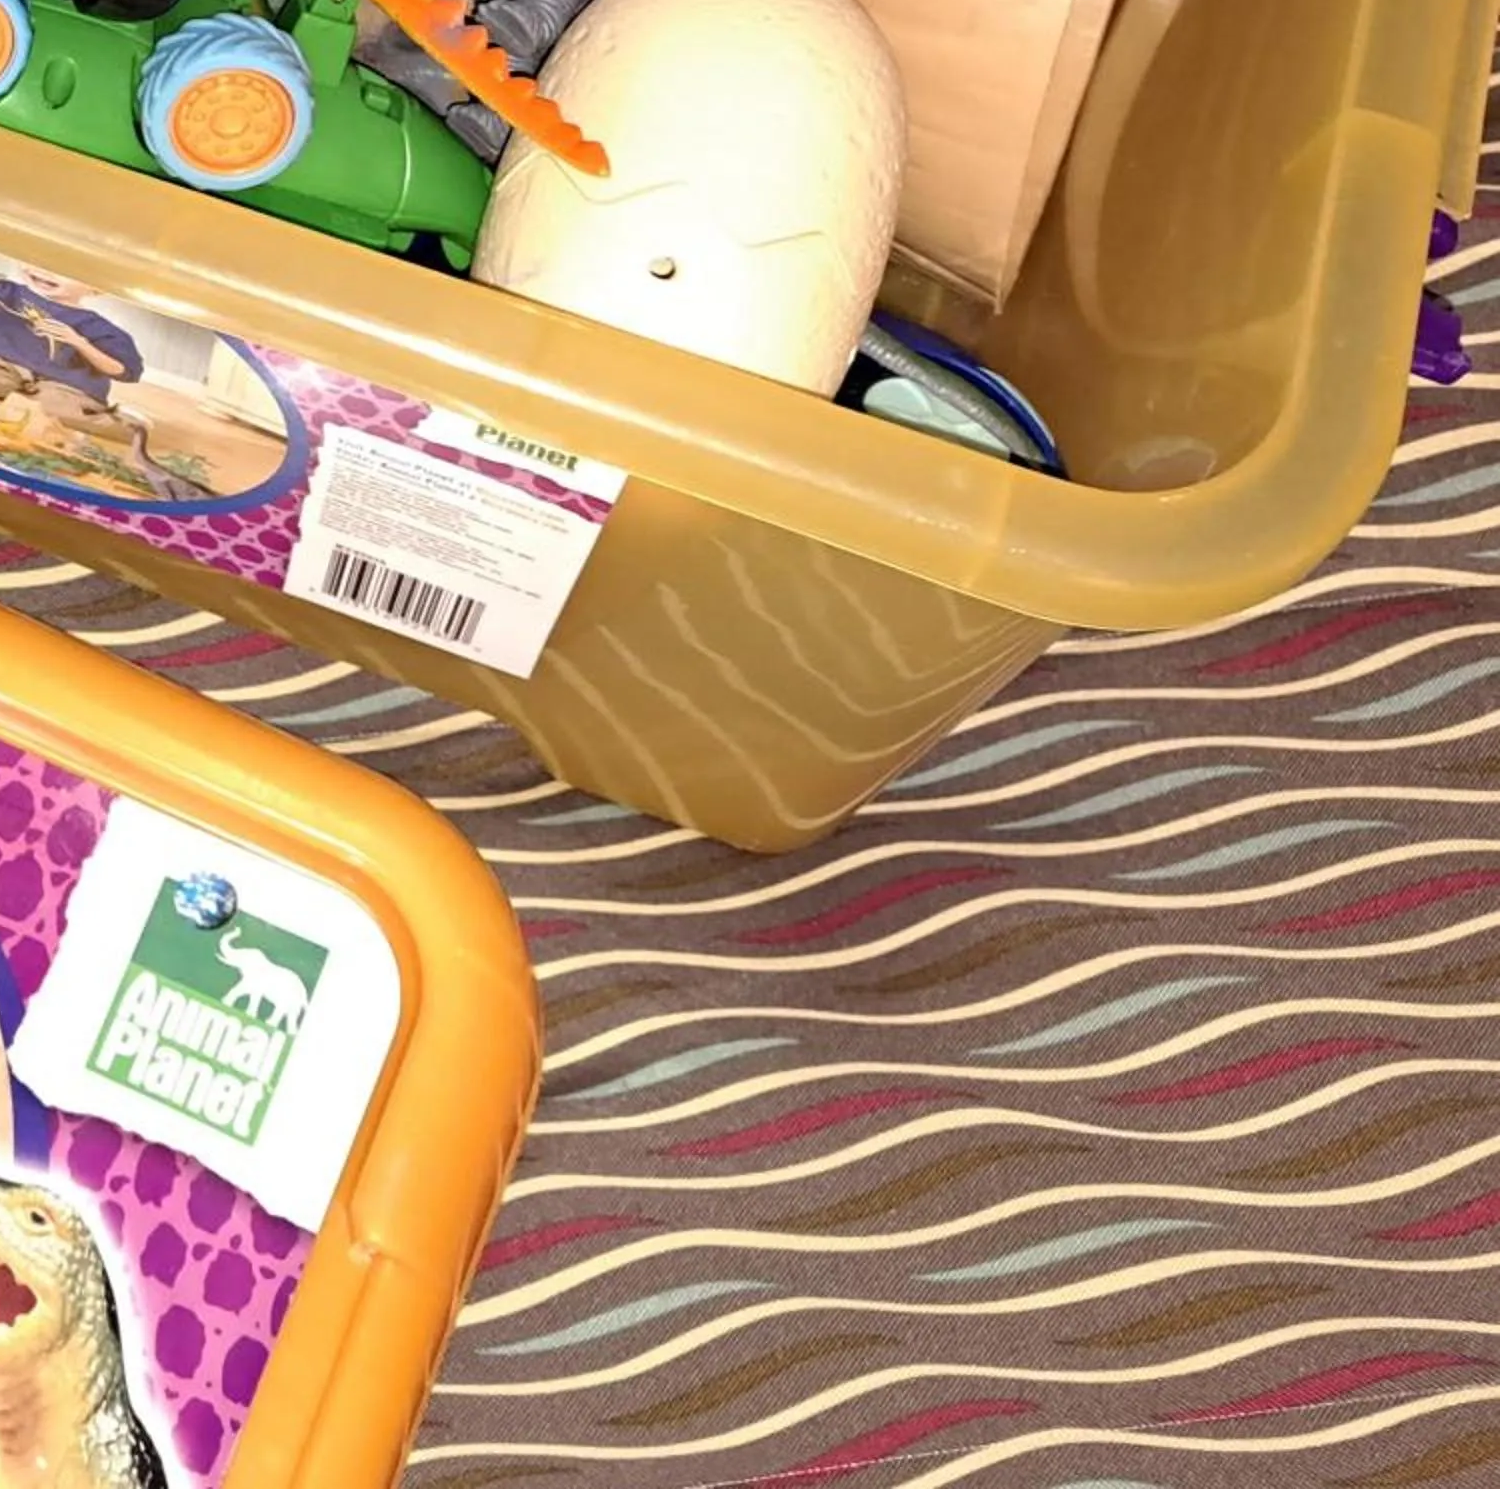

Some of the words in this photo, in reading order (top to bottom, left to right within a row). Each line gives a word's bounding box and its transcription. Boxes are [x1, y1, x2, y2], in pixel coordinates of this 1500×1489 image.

[475, 422, 578, 472] Planet
[95, 1022, 266, 1137] Planet
[115, 970, 287, 1083] Animal
